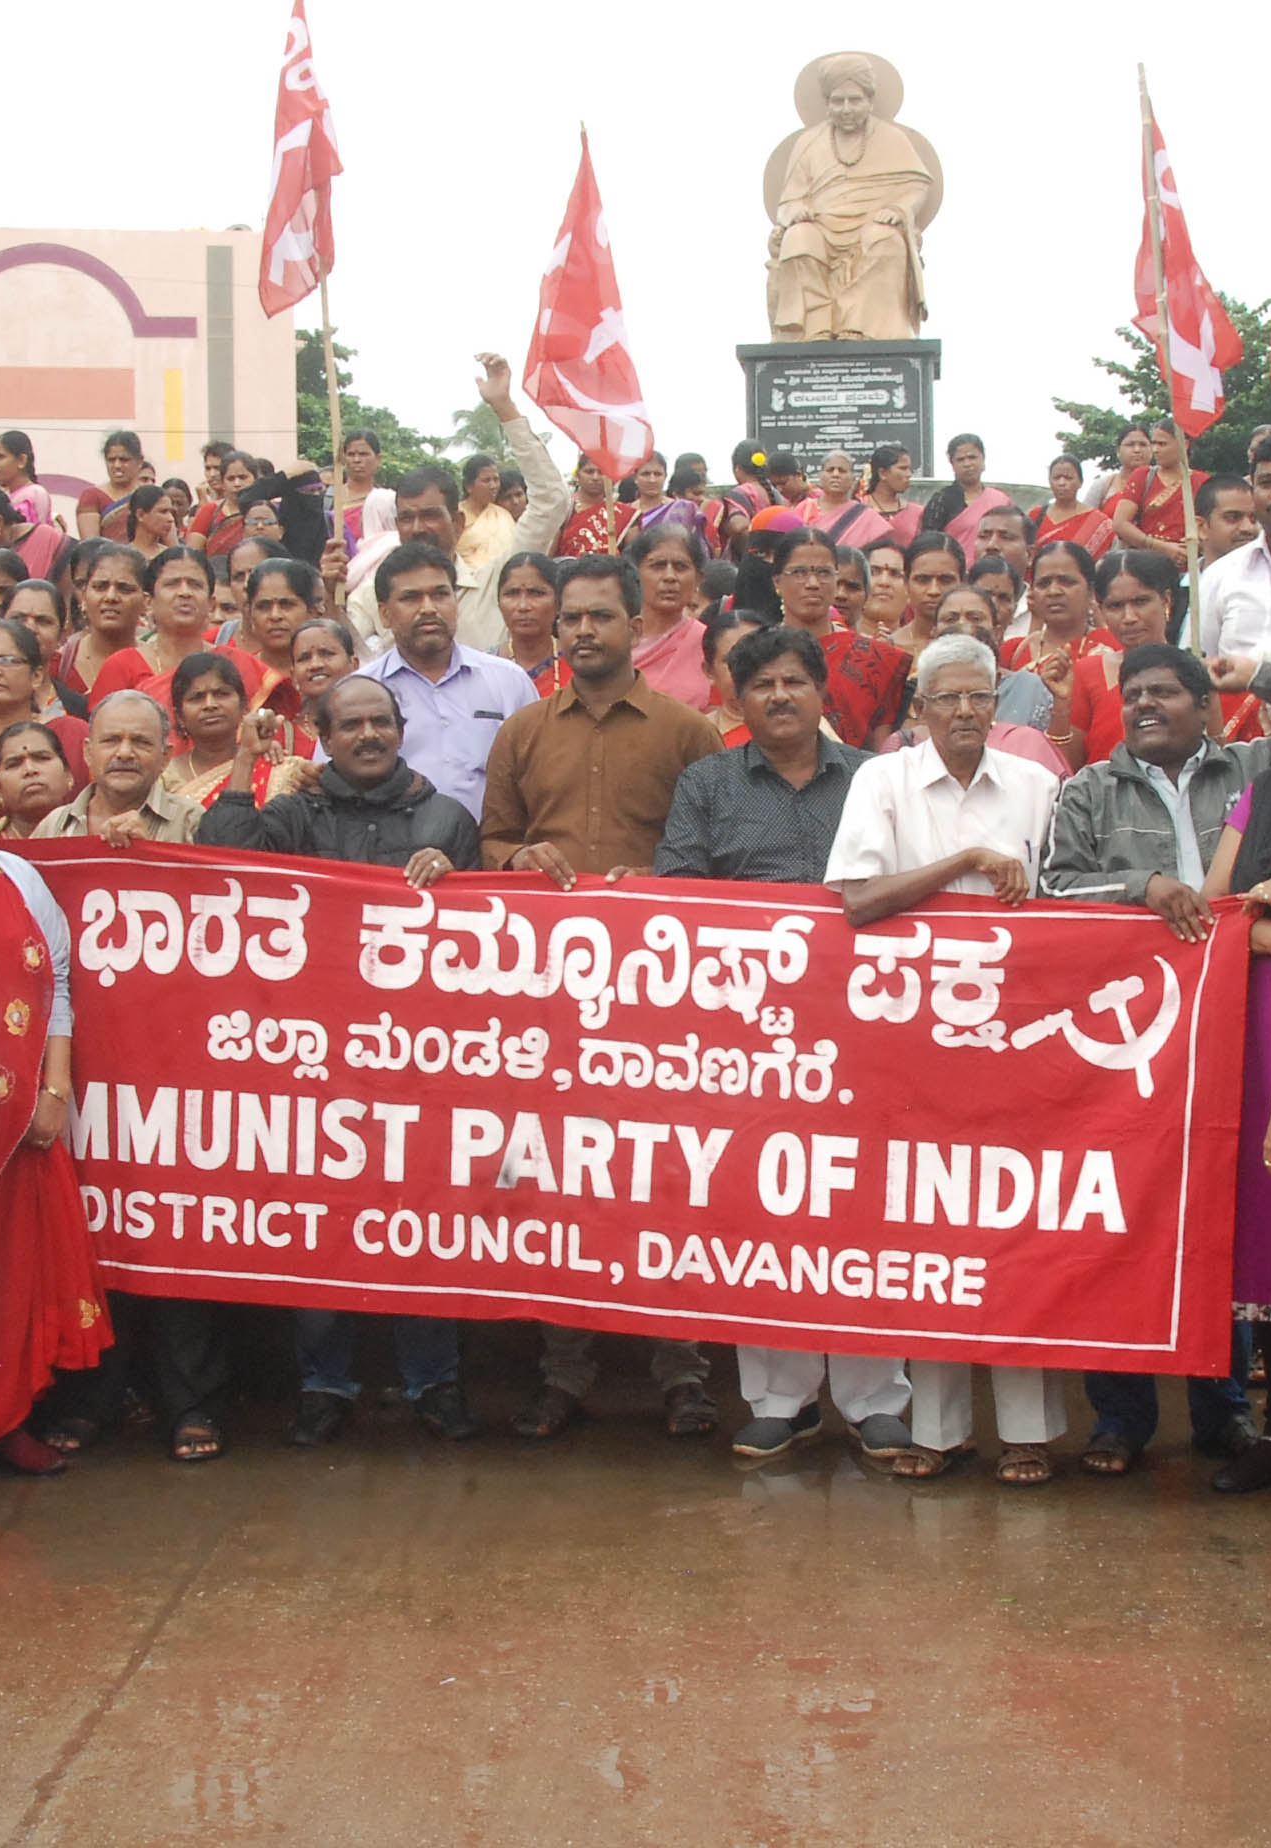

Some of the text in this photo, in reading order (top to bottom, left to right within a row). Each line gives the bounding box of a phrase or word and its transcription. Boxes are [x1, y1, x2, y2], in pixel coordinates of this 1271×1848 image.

[79, 878, 1012, 1052] ಭಾರತ ಕಮ್ಯೂನಿಷ್ಟ್ ಪಕ್ಷ
[207, 1009, 329, 1081] ಜಿಲ್ಲಾ
[451, 1107, 734, 1207] PARTY
[758, 1131, 860, 1218] OF
[884, 1140, 1128, 1234] INDIA
[79, 1185, 987, 1307] DISTRICT COUNCIL, DAVANGERE
